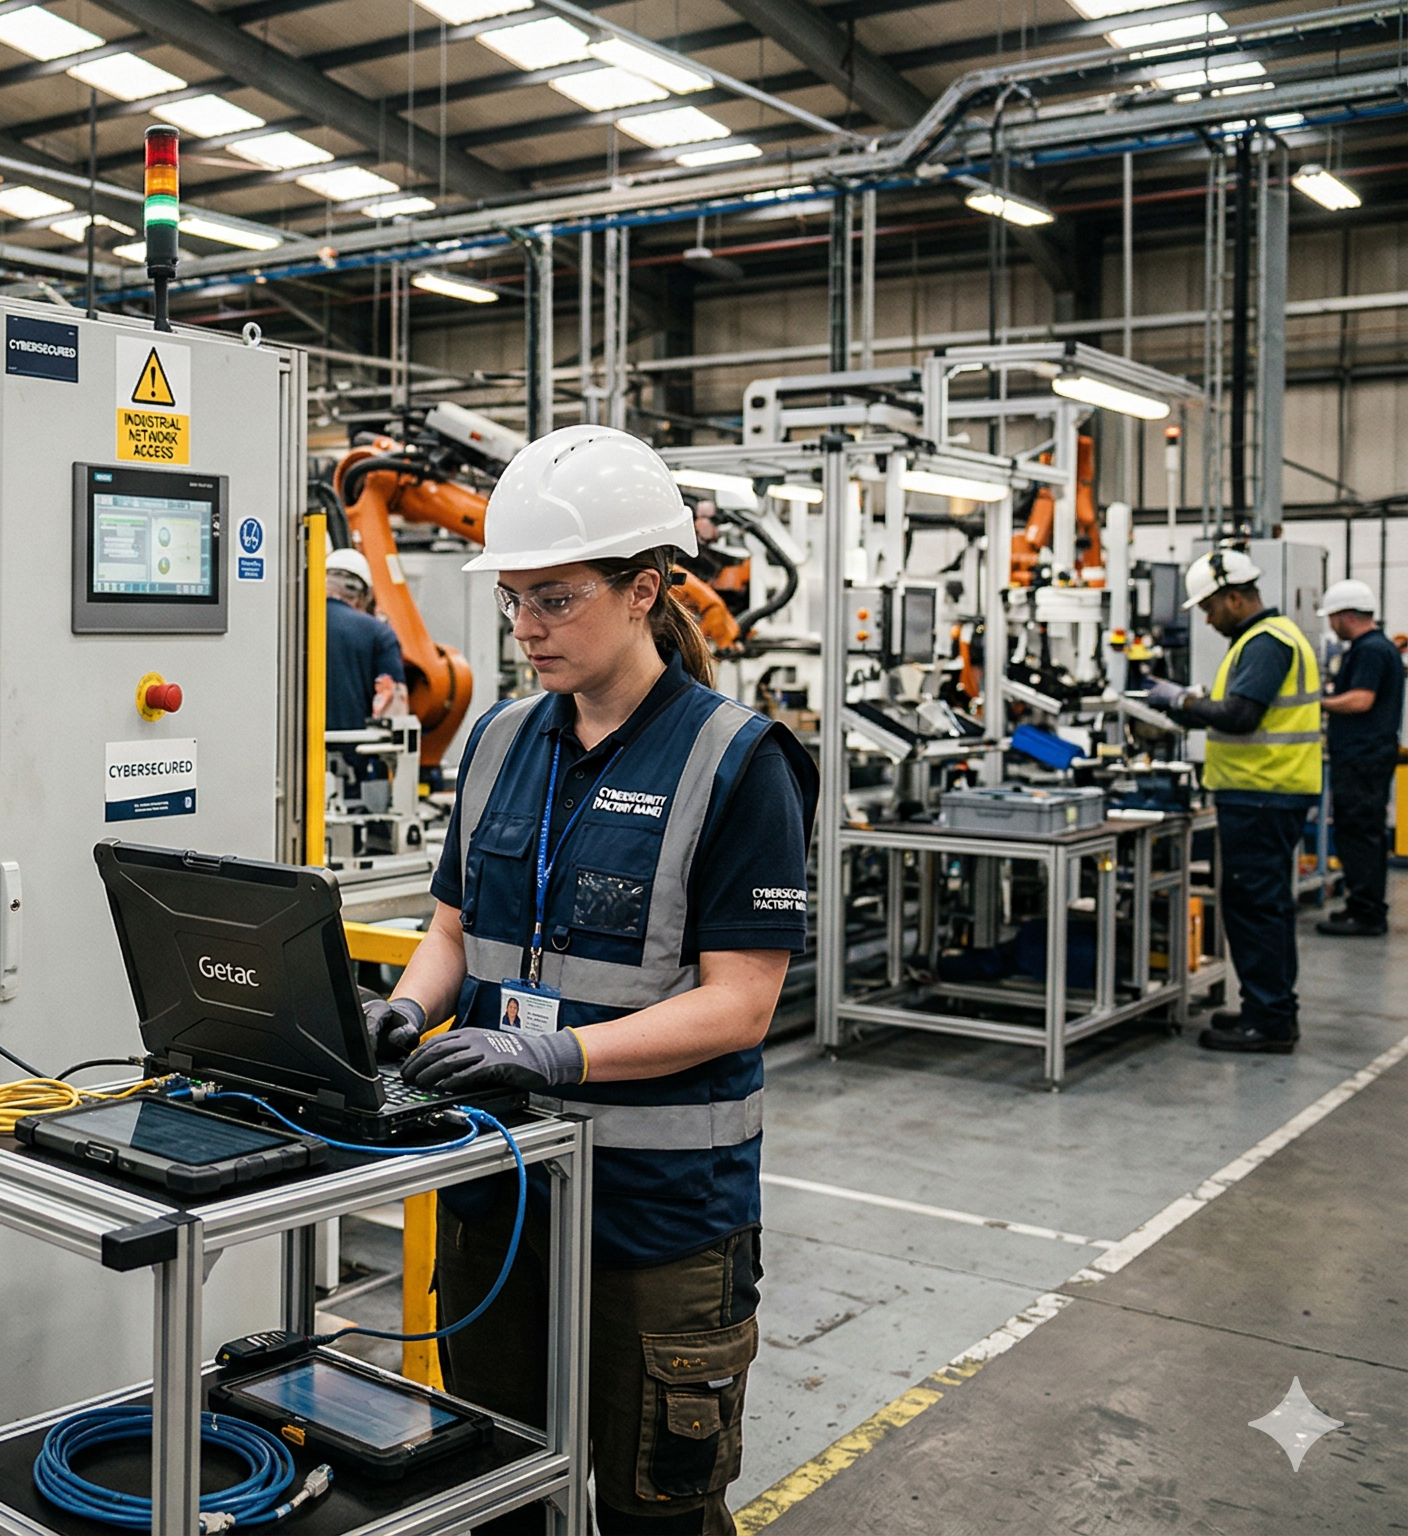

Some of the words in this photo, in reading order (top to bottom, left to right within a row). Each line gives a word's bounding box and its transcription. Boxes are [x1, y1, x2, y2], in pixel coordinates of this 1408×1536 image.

[133, 444, 174, 459] ACCESS
[109, 760, 193, 778] CYBERSECURED
[198, 956, 260, 987] Getac
